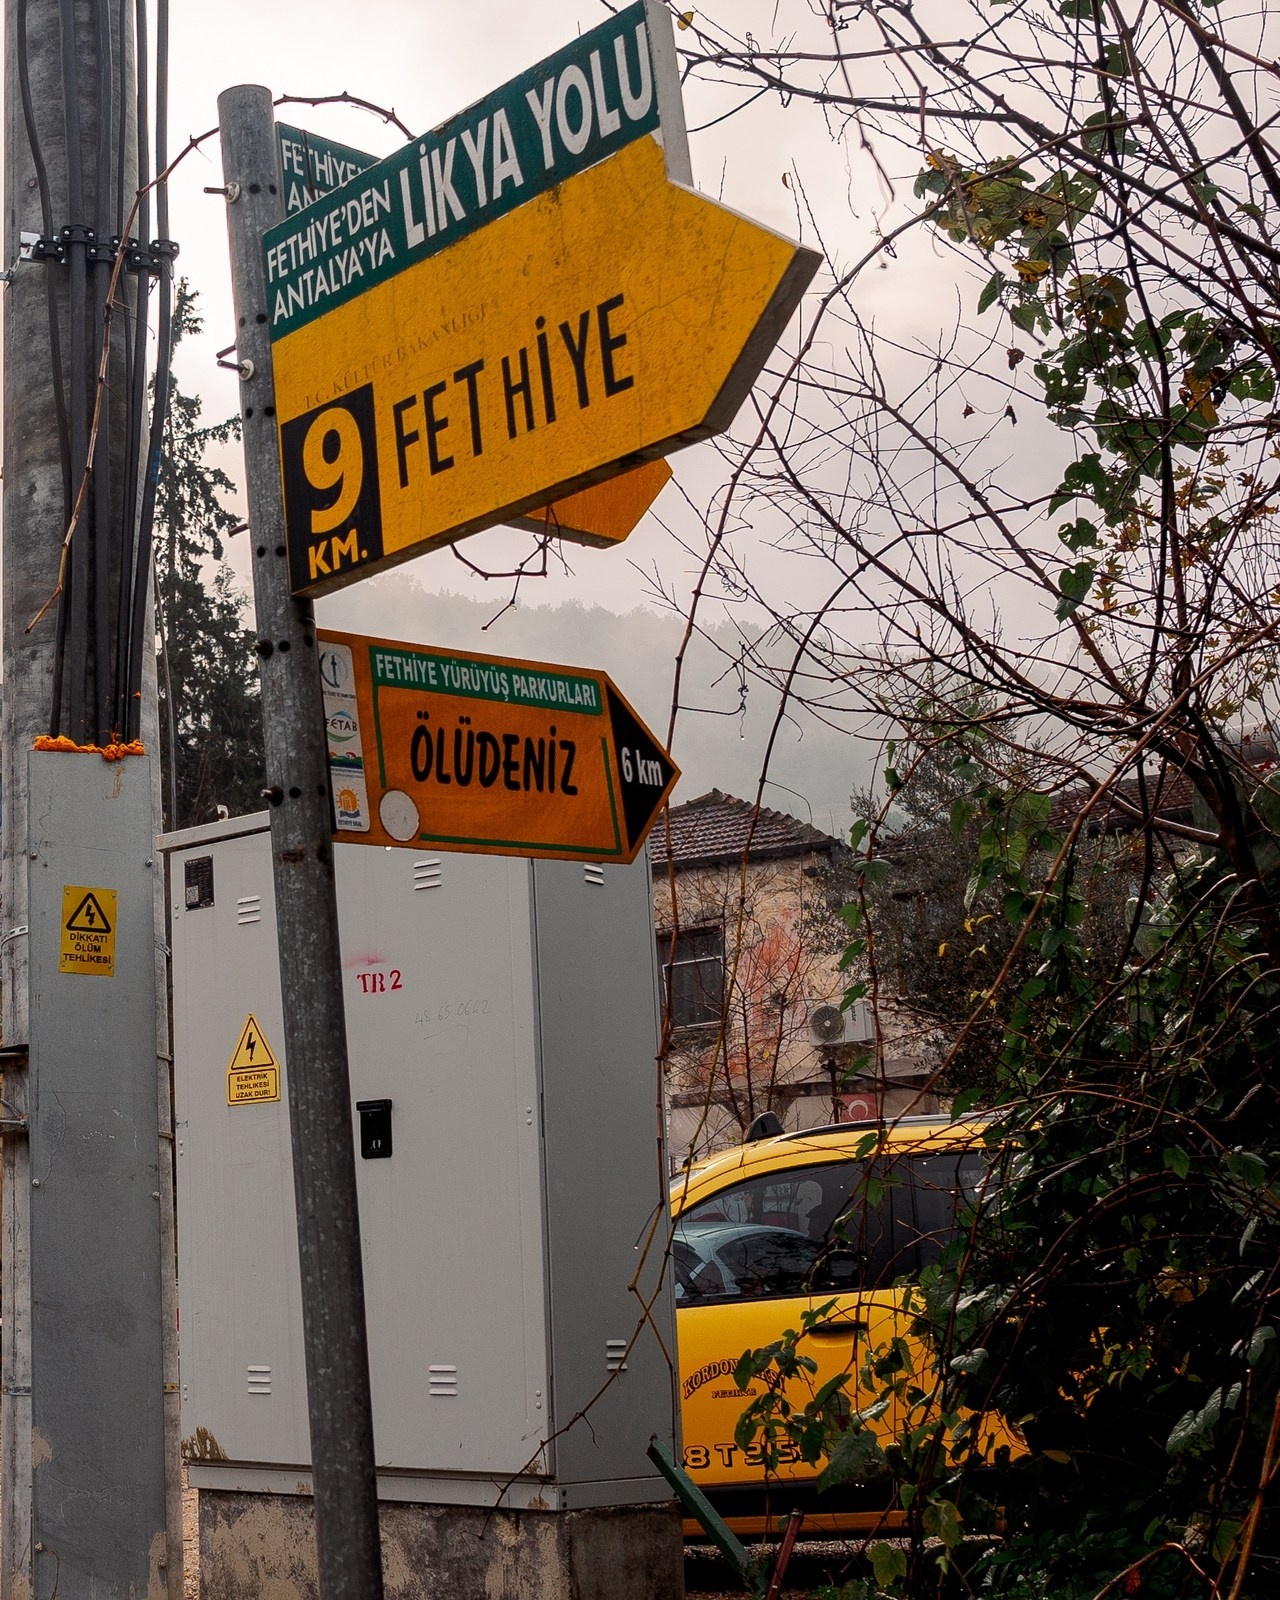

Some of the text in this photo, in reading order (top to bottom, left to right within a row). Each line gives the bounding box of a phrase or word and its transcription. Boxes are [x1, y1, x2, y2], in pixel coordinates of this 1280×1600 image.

[399, 21, 653, 249] LİKYA YOLU
[287, 181, 328, 211] AN
[267, 179, 391, 283] FETHİYE'DEN
[273, 228, 396, 326] ANTALYA'YA
[392, 293, 634, 489] FETHİYE
[303, 407, 363, 533] 9
[308, 528, 368, 580] KM.
[376, 653, 597, 707] FETHİYE YÜRÜYÜŞ PARKURLARI
[410, 710, 578, 796] ÖLÜDENİZ
[622, 747, 663, 786] 6 km
[63, 953, 111, 964] TEHLİKESİ
[74, 942, 101, 953] ÖLÜM
[357, 969, 403, 993] TR 2
